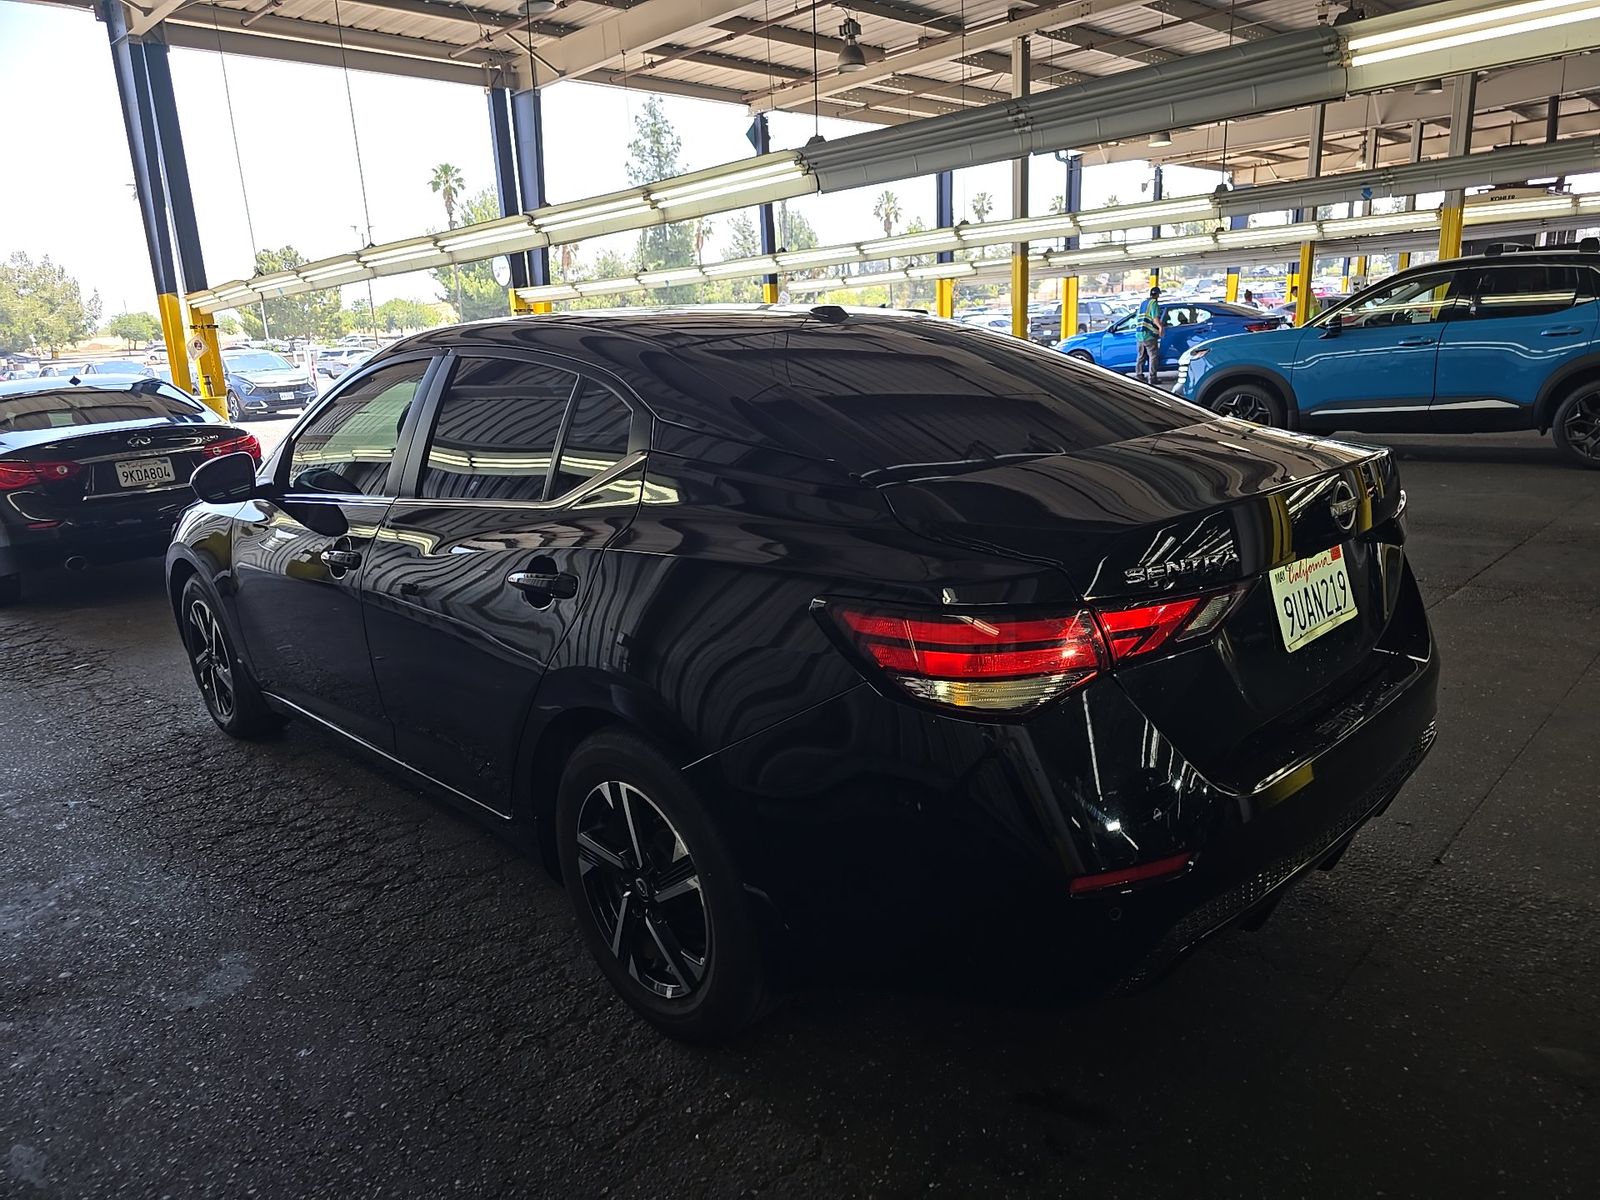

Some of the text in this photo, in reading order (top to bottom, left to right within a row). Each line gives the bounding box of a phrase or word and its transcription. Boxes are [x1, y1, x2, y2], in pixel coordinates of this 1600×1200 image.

[121, 466, 171, 483] 9KDA804
[1330, 499, 1358, 517] NISS
[1124, 549, 1239, 584] SENTRA
[1285, 556, 1333, 584] California
[1283, 569, 1347, 638] 9UAN219
